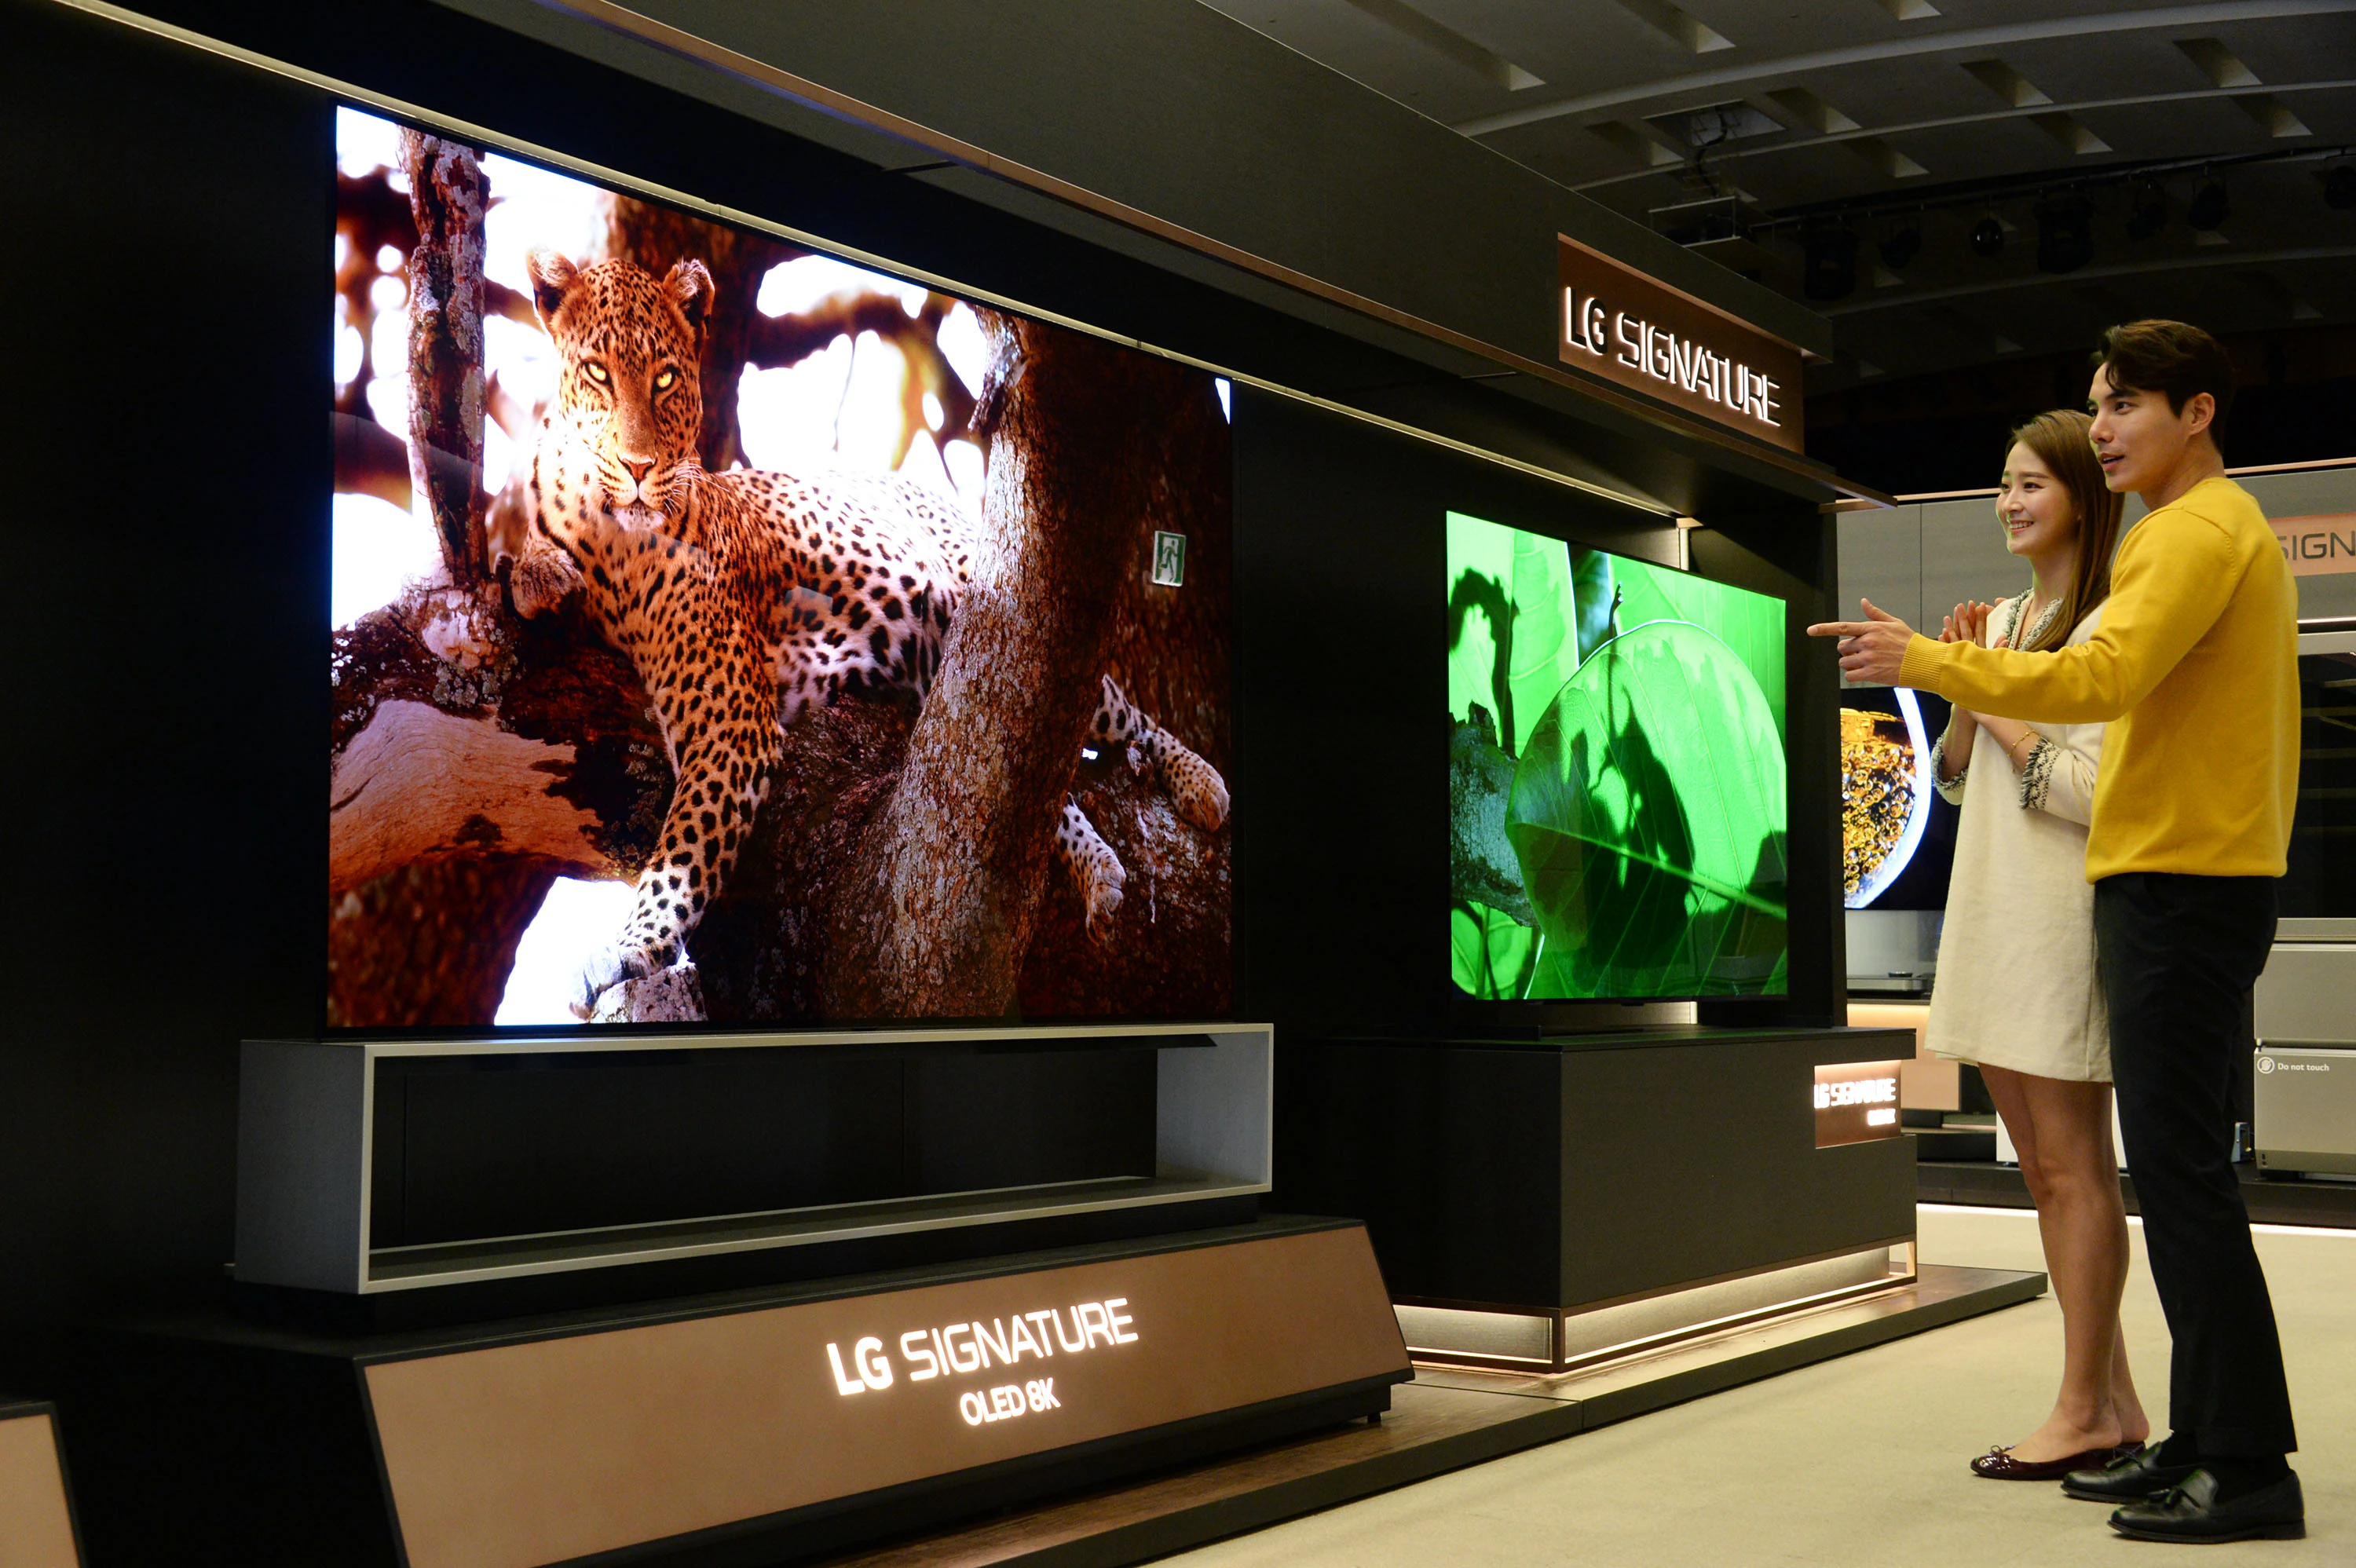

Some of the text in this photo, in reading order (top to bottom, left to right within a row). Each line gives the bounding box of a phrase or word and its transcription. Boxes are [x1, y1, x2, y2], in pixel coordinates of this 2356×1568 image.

[1565, 286, 1782, 427] LG SIGNATURE
[2307, 1063, 2329, 1072] touch
[826, 1297, 1139, 1396] LG SIGNATURE
[959, 1376, 1061, 1427] OLED 8K
